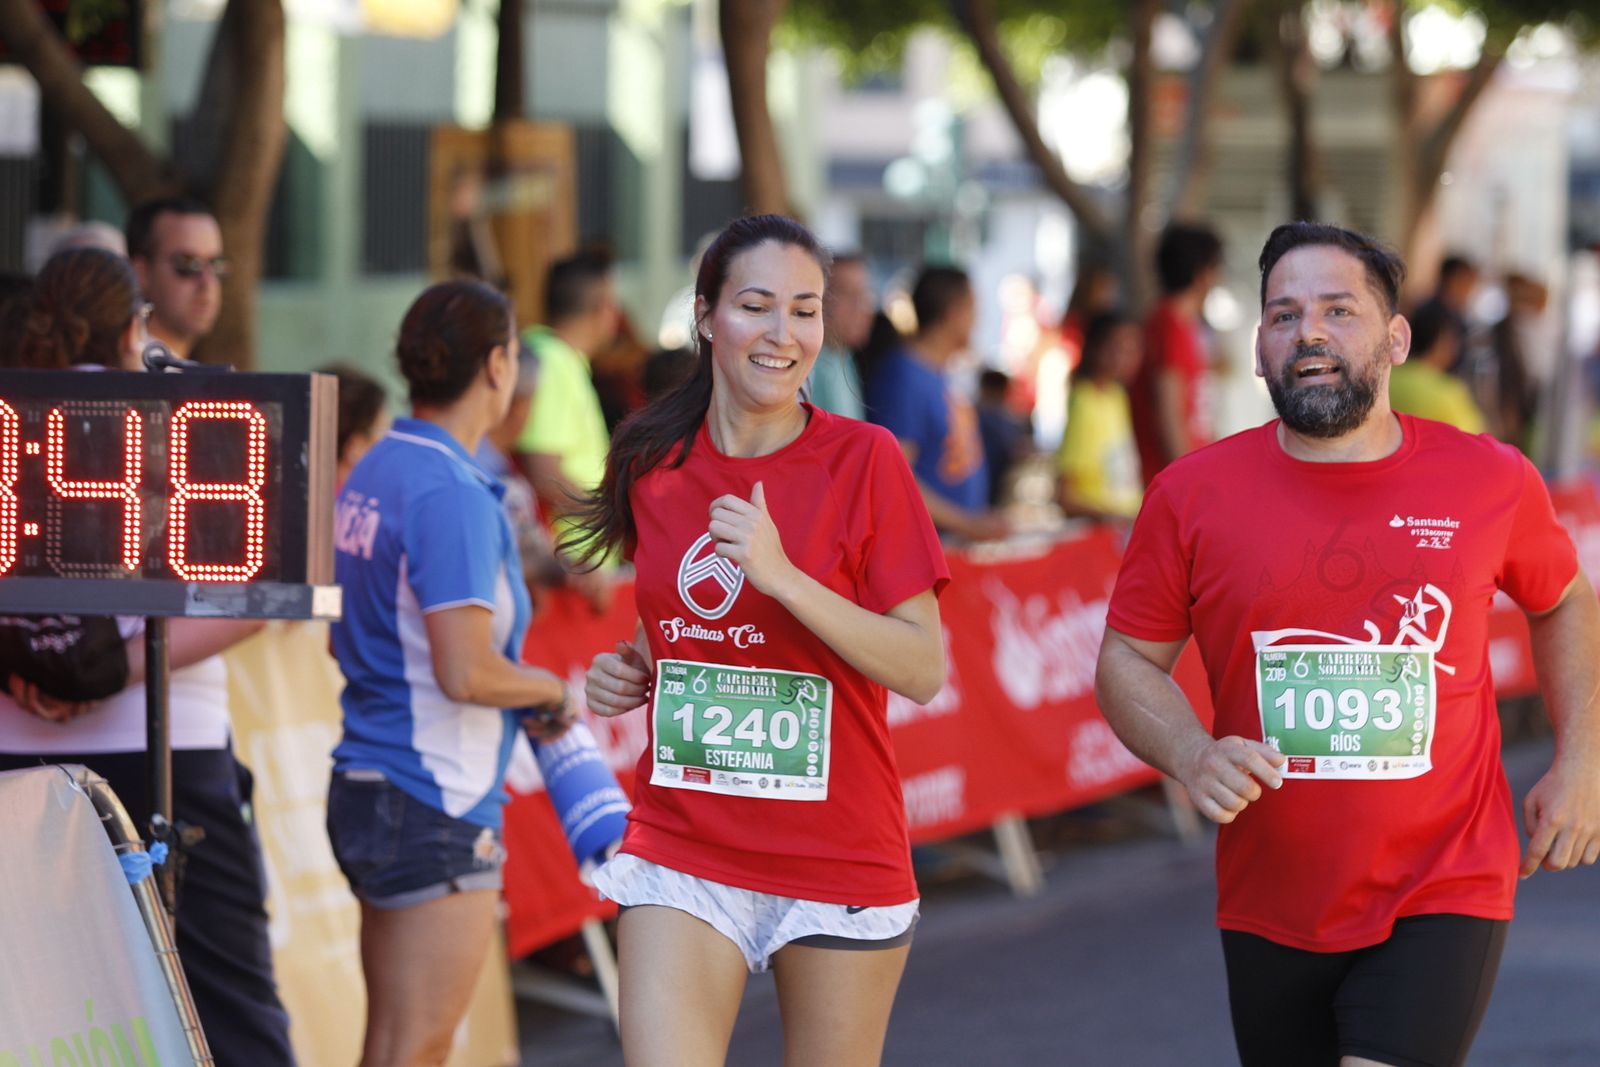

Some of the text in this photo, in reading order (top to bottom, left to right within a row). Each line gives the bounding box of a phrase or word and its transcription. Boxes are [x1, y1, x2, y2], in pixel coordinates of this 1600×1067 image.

[0, 399, 266, 582] :48
[1406, 516, 1461, 529] Santander
[659, 616, 766, 649] Salinas Car
[1293, 651, 1309, 678] 6
[1317, 653, 1381, 665] CARRERA
[1264, 667, 1287, 682] 2019
[1317, 664, 1381, 676] SOLIDARIA
[663, 680, 686, 696] 2019
[692, 668, 707, 694] 6
[716, 672, 778, 688] CARRERA
[715, 683, 777, 697] SOLIDARIA
[1275, 687, 1404, 731] 1093
[673, 702, 800, 750] 1240
[1330, 731, 1361, 752] RÍOS
[658, 745, 675, 762] 3k
[705, 749, 774, 770] ESTEFANIA
